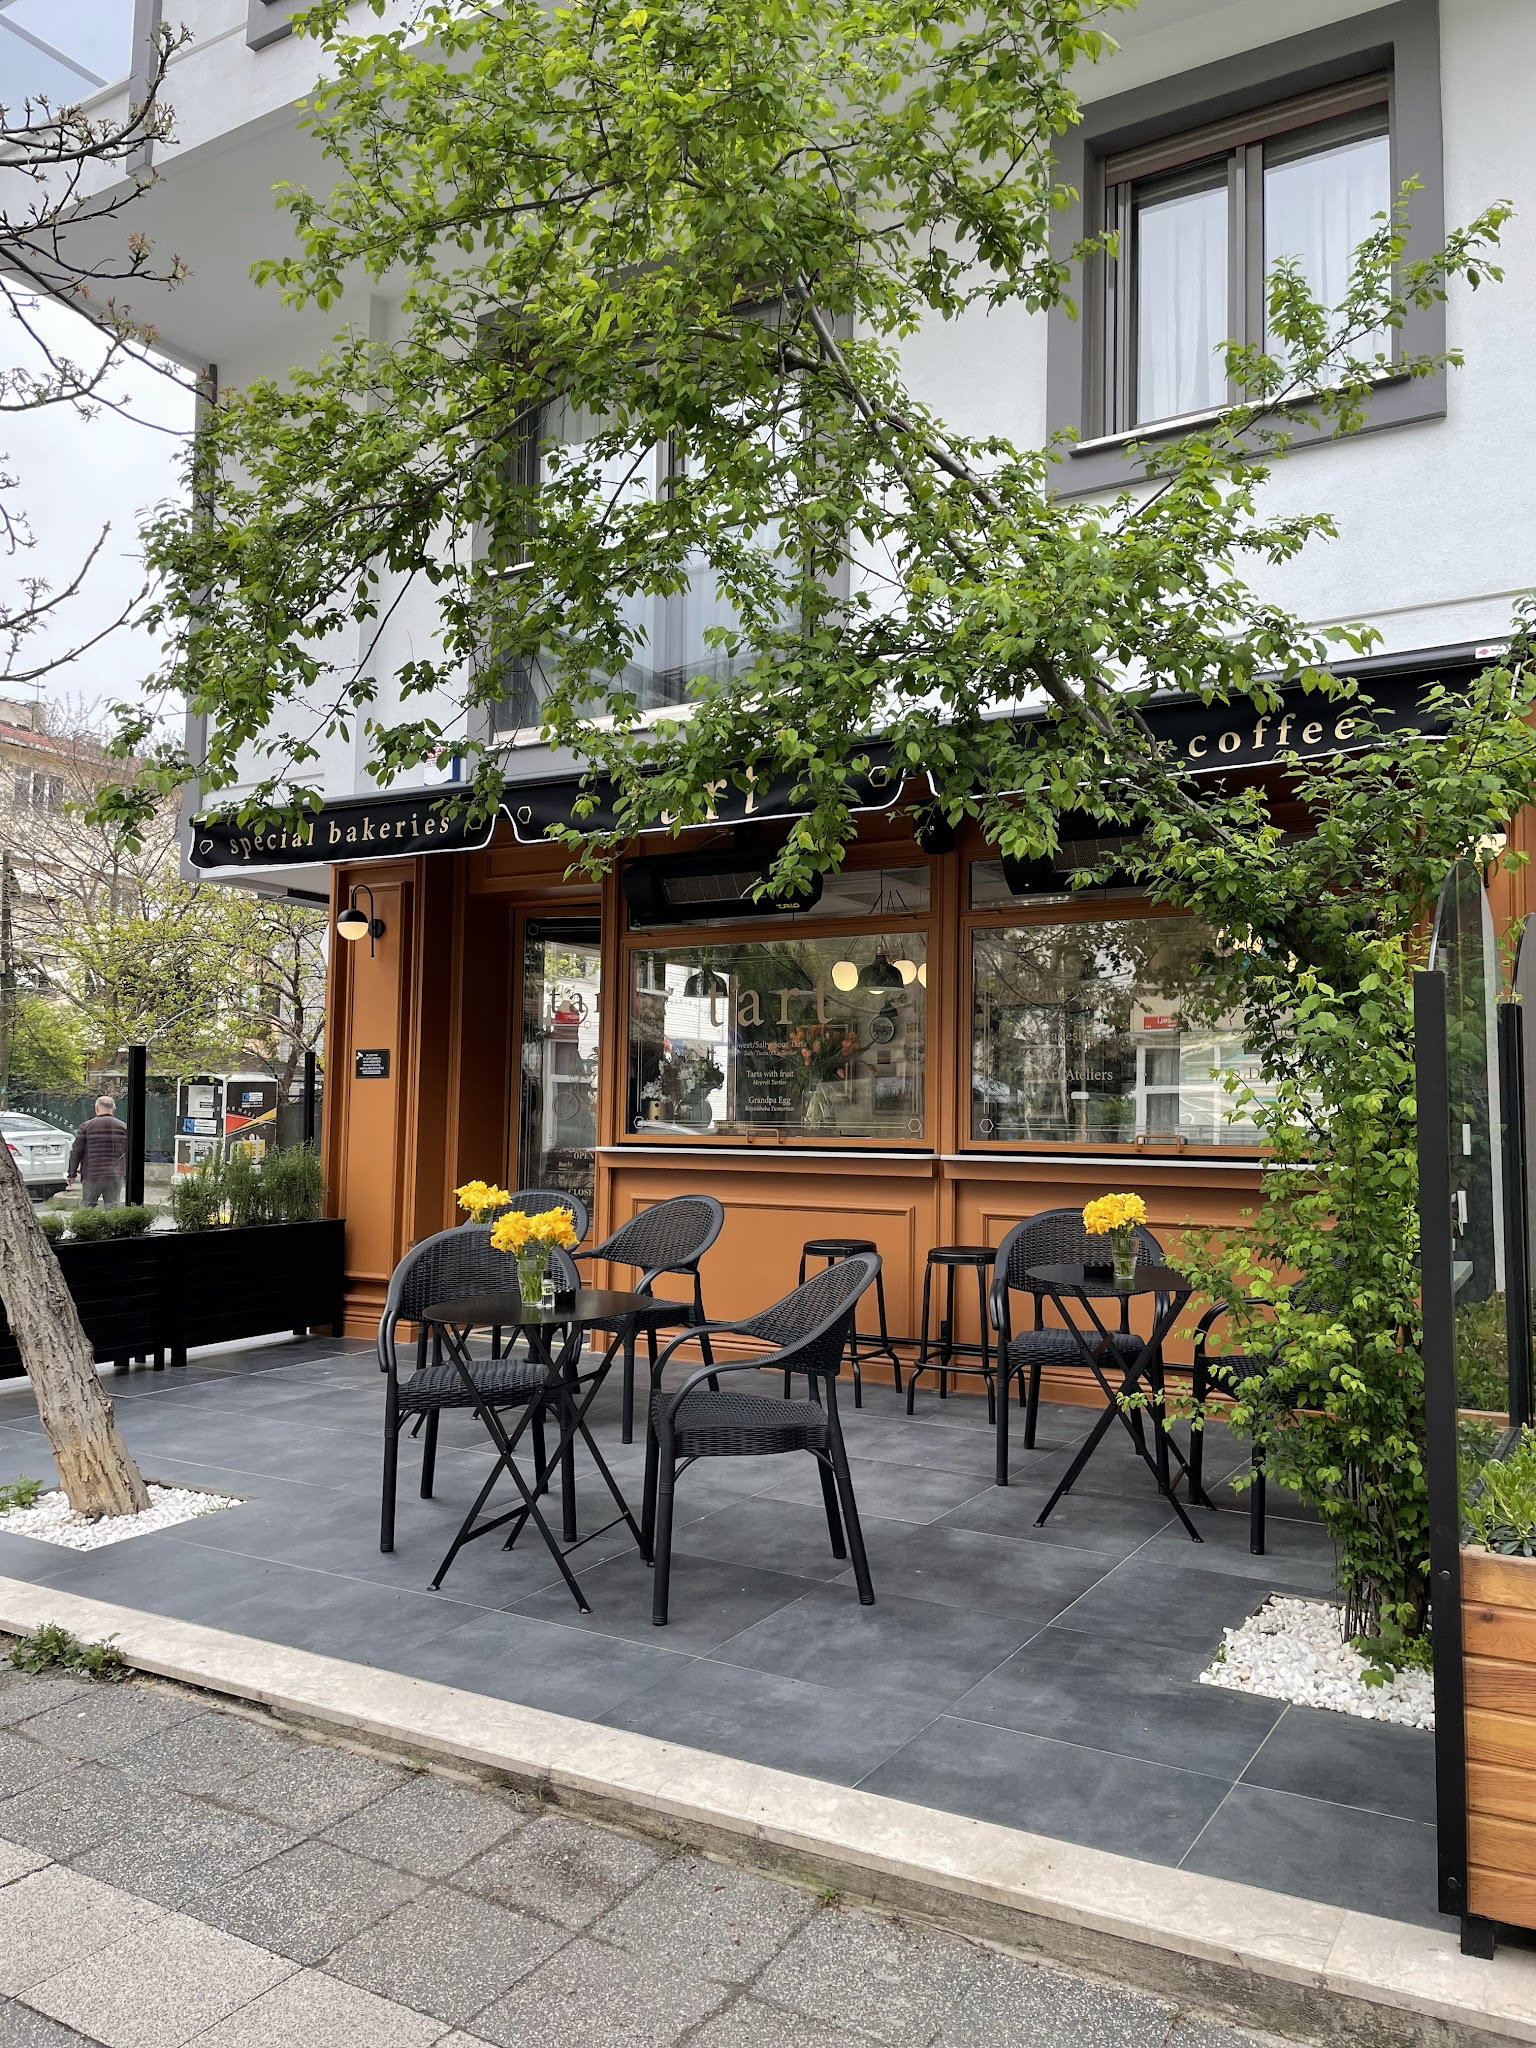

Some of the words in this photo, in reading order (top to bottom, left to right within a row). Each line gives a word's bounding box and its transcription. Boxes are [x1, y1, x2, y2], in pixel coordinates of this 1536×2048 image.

[1188, 713, 1356, 758] coffee
[229, 822, 314, 860] special
[328, 813, 451, 844] bakeries
[709, 978, 833, 1028] tart
[746, 1069, 763, 1078] Tarts
[763, 1069, 778, 1078] with
[779, 1069, 794, 1078] fruit
[1065, 1068, 1114, 1081] Ateliers
[748, 1096, 777, 1106] Grandpa
[779, 1097, 791, 1106] Egg
[573, 1151, 595, 1160] OPEN
